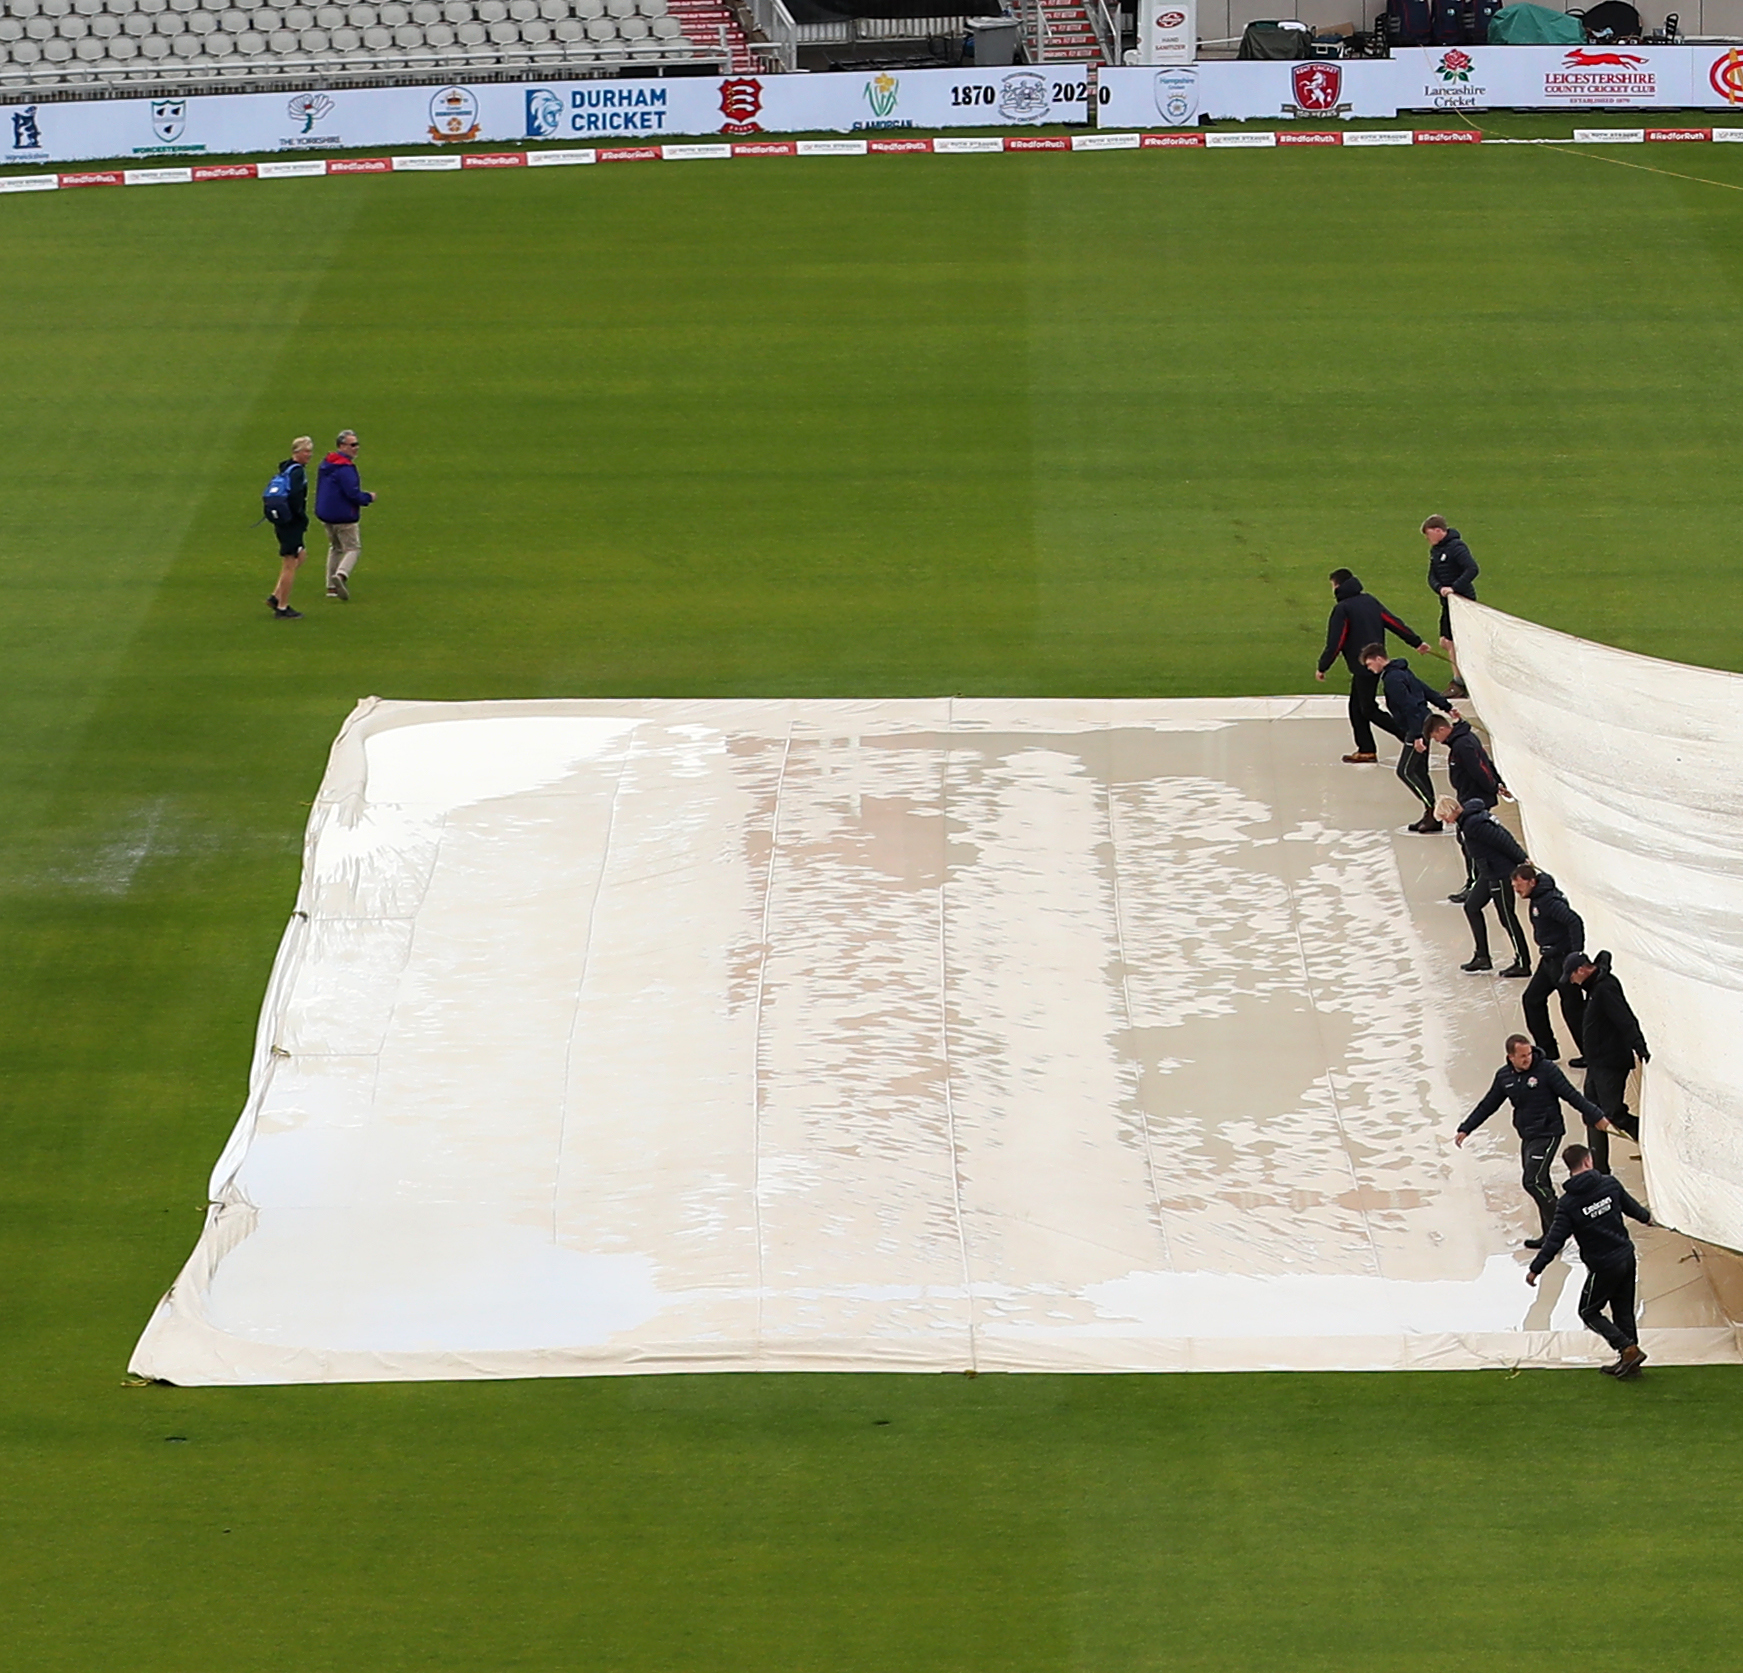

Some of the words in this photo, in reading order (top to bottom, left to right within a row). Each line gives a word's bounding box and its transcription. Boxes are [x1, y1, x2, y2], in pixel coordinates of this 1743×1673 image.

[1544, 73, 1656, 84] LEICESTERSHIRE
[1424, 85, 1487, 97] Lancashire
[1544, 85, 1581, 93] COUNTY
[1583, 85, 1624, 93] CRICKET
[1626, 84, 1656, 93] CLUB
[572, 88, 667, 109] DURHAM
[951, 85, 995, 105] 1870
[1434, 96, 1477, 108] Cricket
[572, 110, 667, 131] CRICKET
[1280, 134, 1335, 144] #RedforRuth
[872, 141, 926, 152] #RedforRuth
